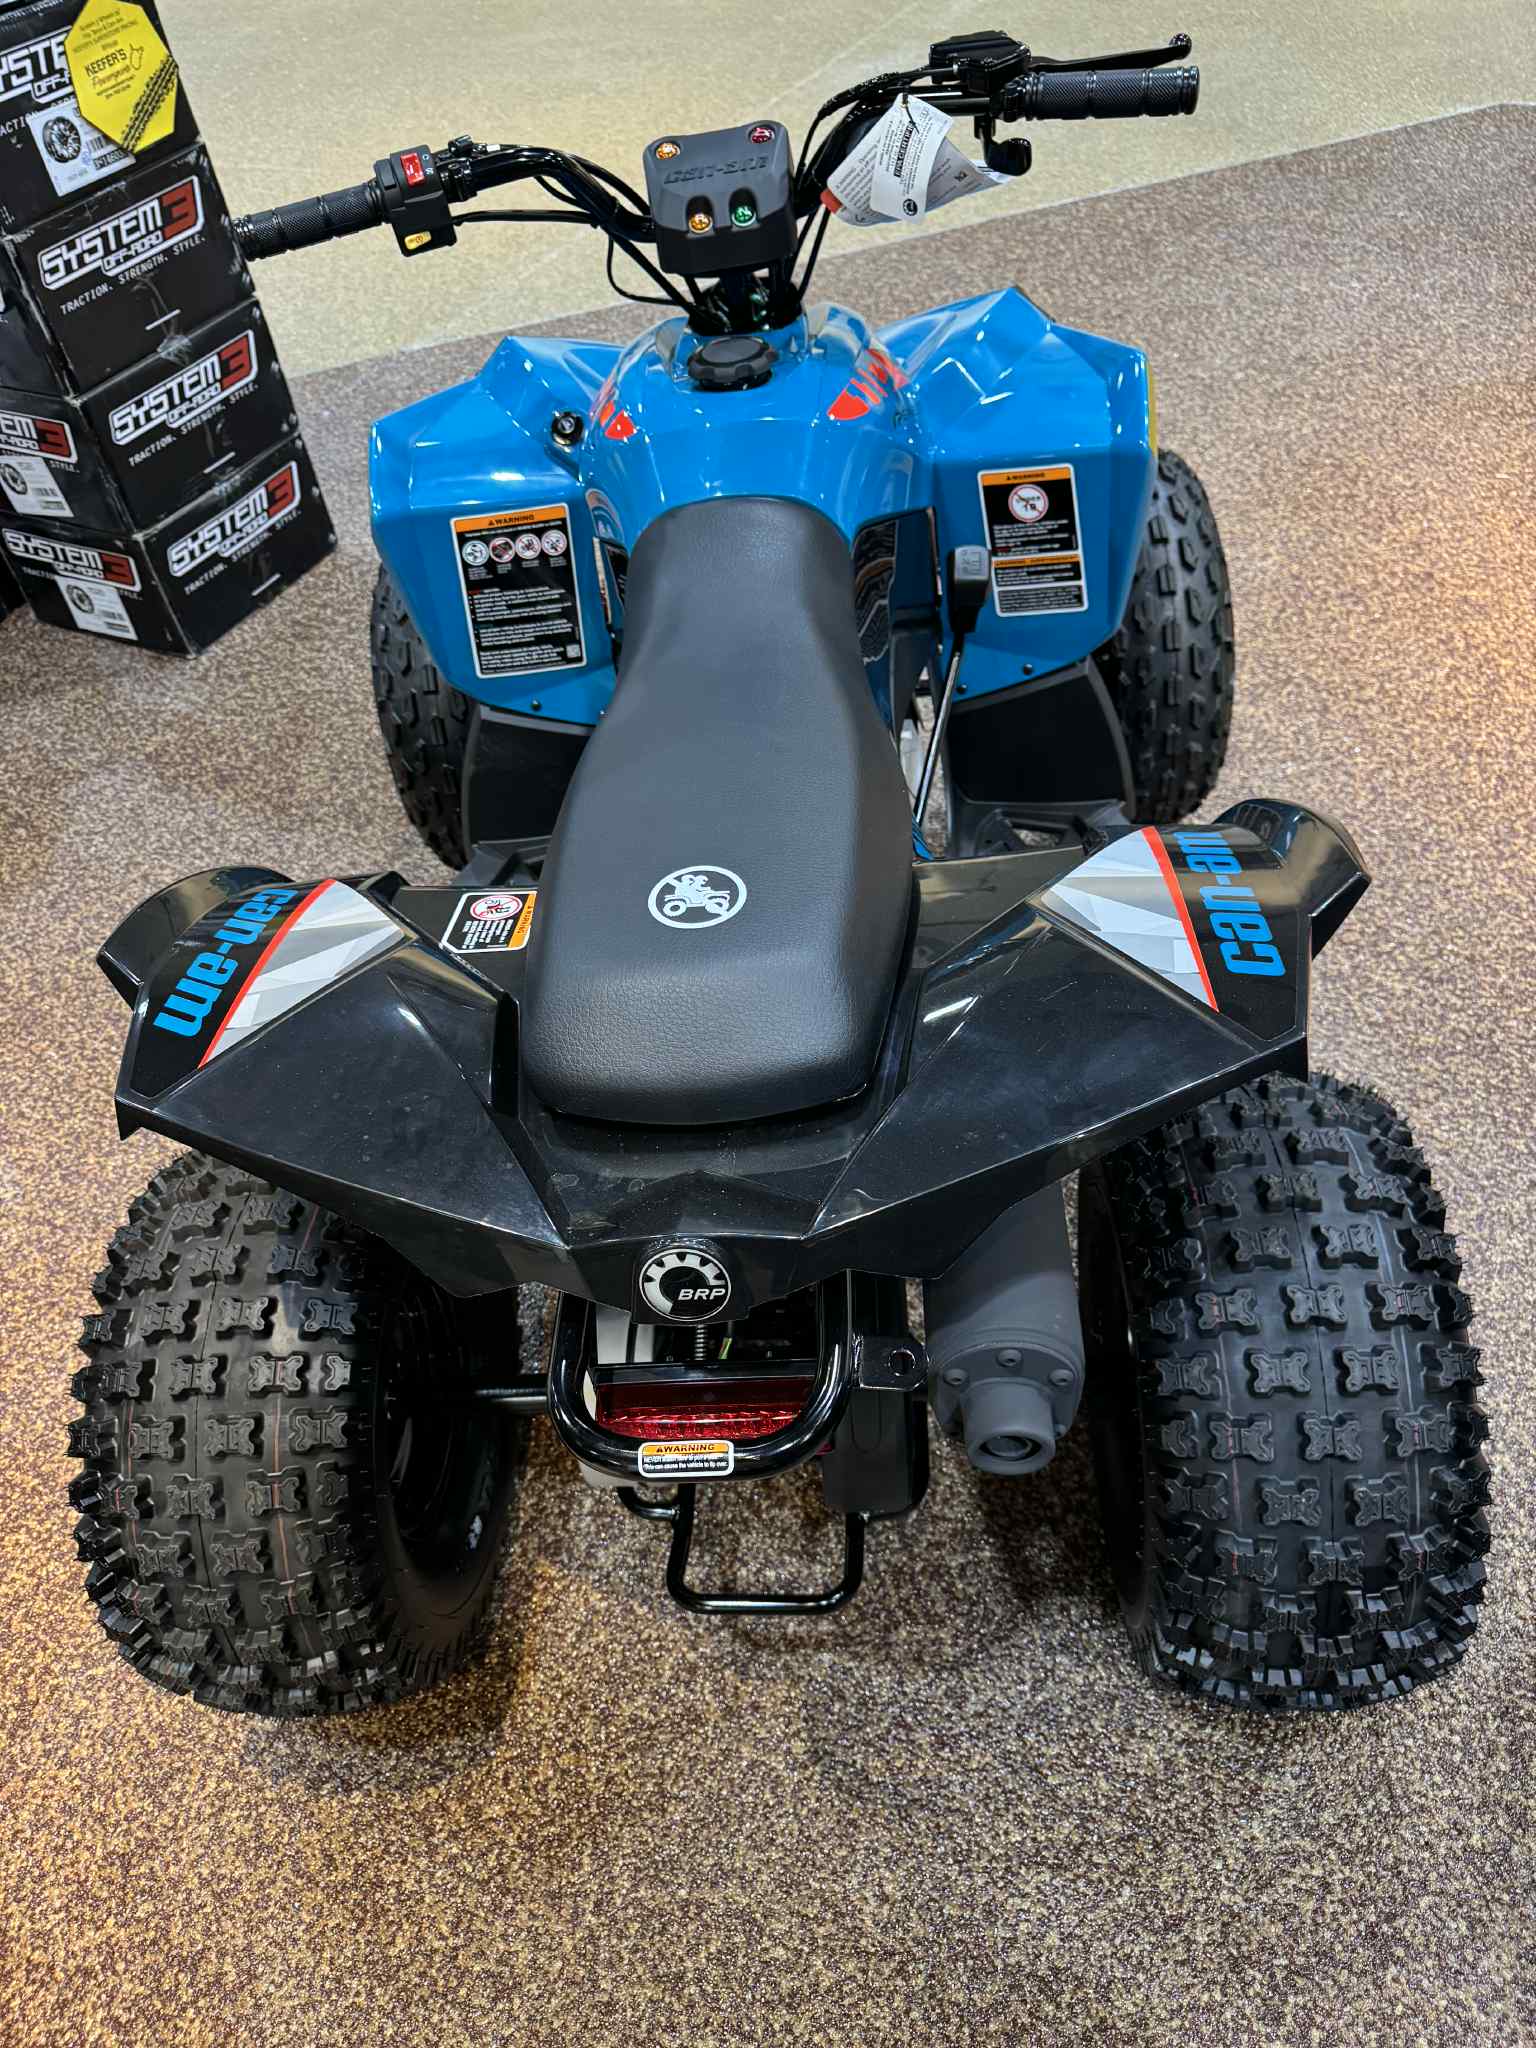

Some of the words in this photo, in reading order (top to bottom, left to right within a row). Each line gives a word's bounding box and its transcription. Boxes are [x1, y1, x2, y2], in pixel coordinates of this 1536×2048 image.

[0, 33, 67, 92] YSTE
[85, 47, 127, 77] KEEFER'S
[42, 199, 163, 284] SYSTEM
[161, 181, 197, 240] 3
[104, 230, 163, 270] OFF-ROAD
[60, 283, 113, 315] TRACTION.
[118, 253, 168, 285] STRENGTH.
[173, 235, 206, 255] STYLE.
[113, 354, 222, 439] SYSTEM
[220, 335, 253, 392] 3
[169, 382, 222, 422] OFF-ROAD
[128, 434, 176, 467] TRACTION.
[181, 404, 226, 435] STRENGTH.
[229, 382, 258, 404] STYLE.
[171, 486, 269, 573] SYSTEM
[266, 467, 295, 520] 3
[495, 514, 535, 526] WARNING
[6, 531, 103, 570] SYSTEM
[101, 553, 135, 586] 3
[184, 563, 228, 595] TRACTION.
[1172, 831, 1286, 977] can-am
[153, 888, 298, 1037] can-am
[678, 1288, 726, 1301] BRP
[664, 1444, 715, 1453] WARNING
